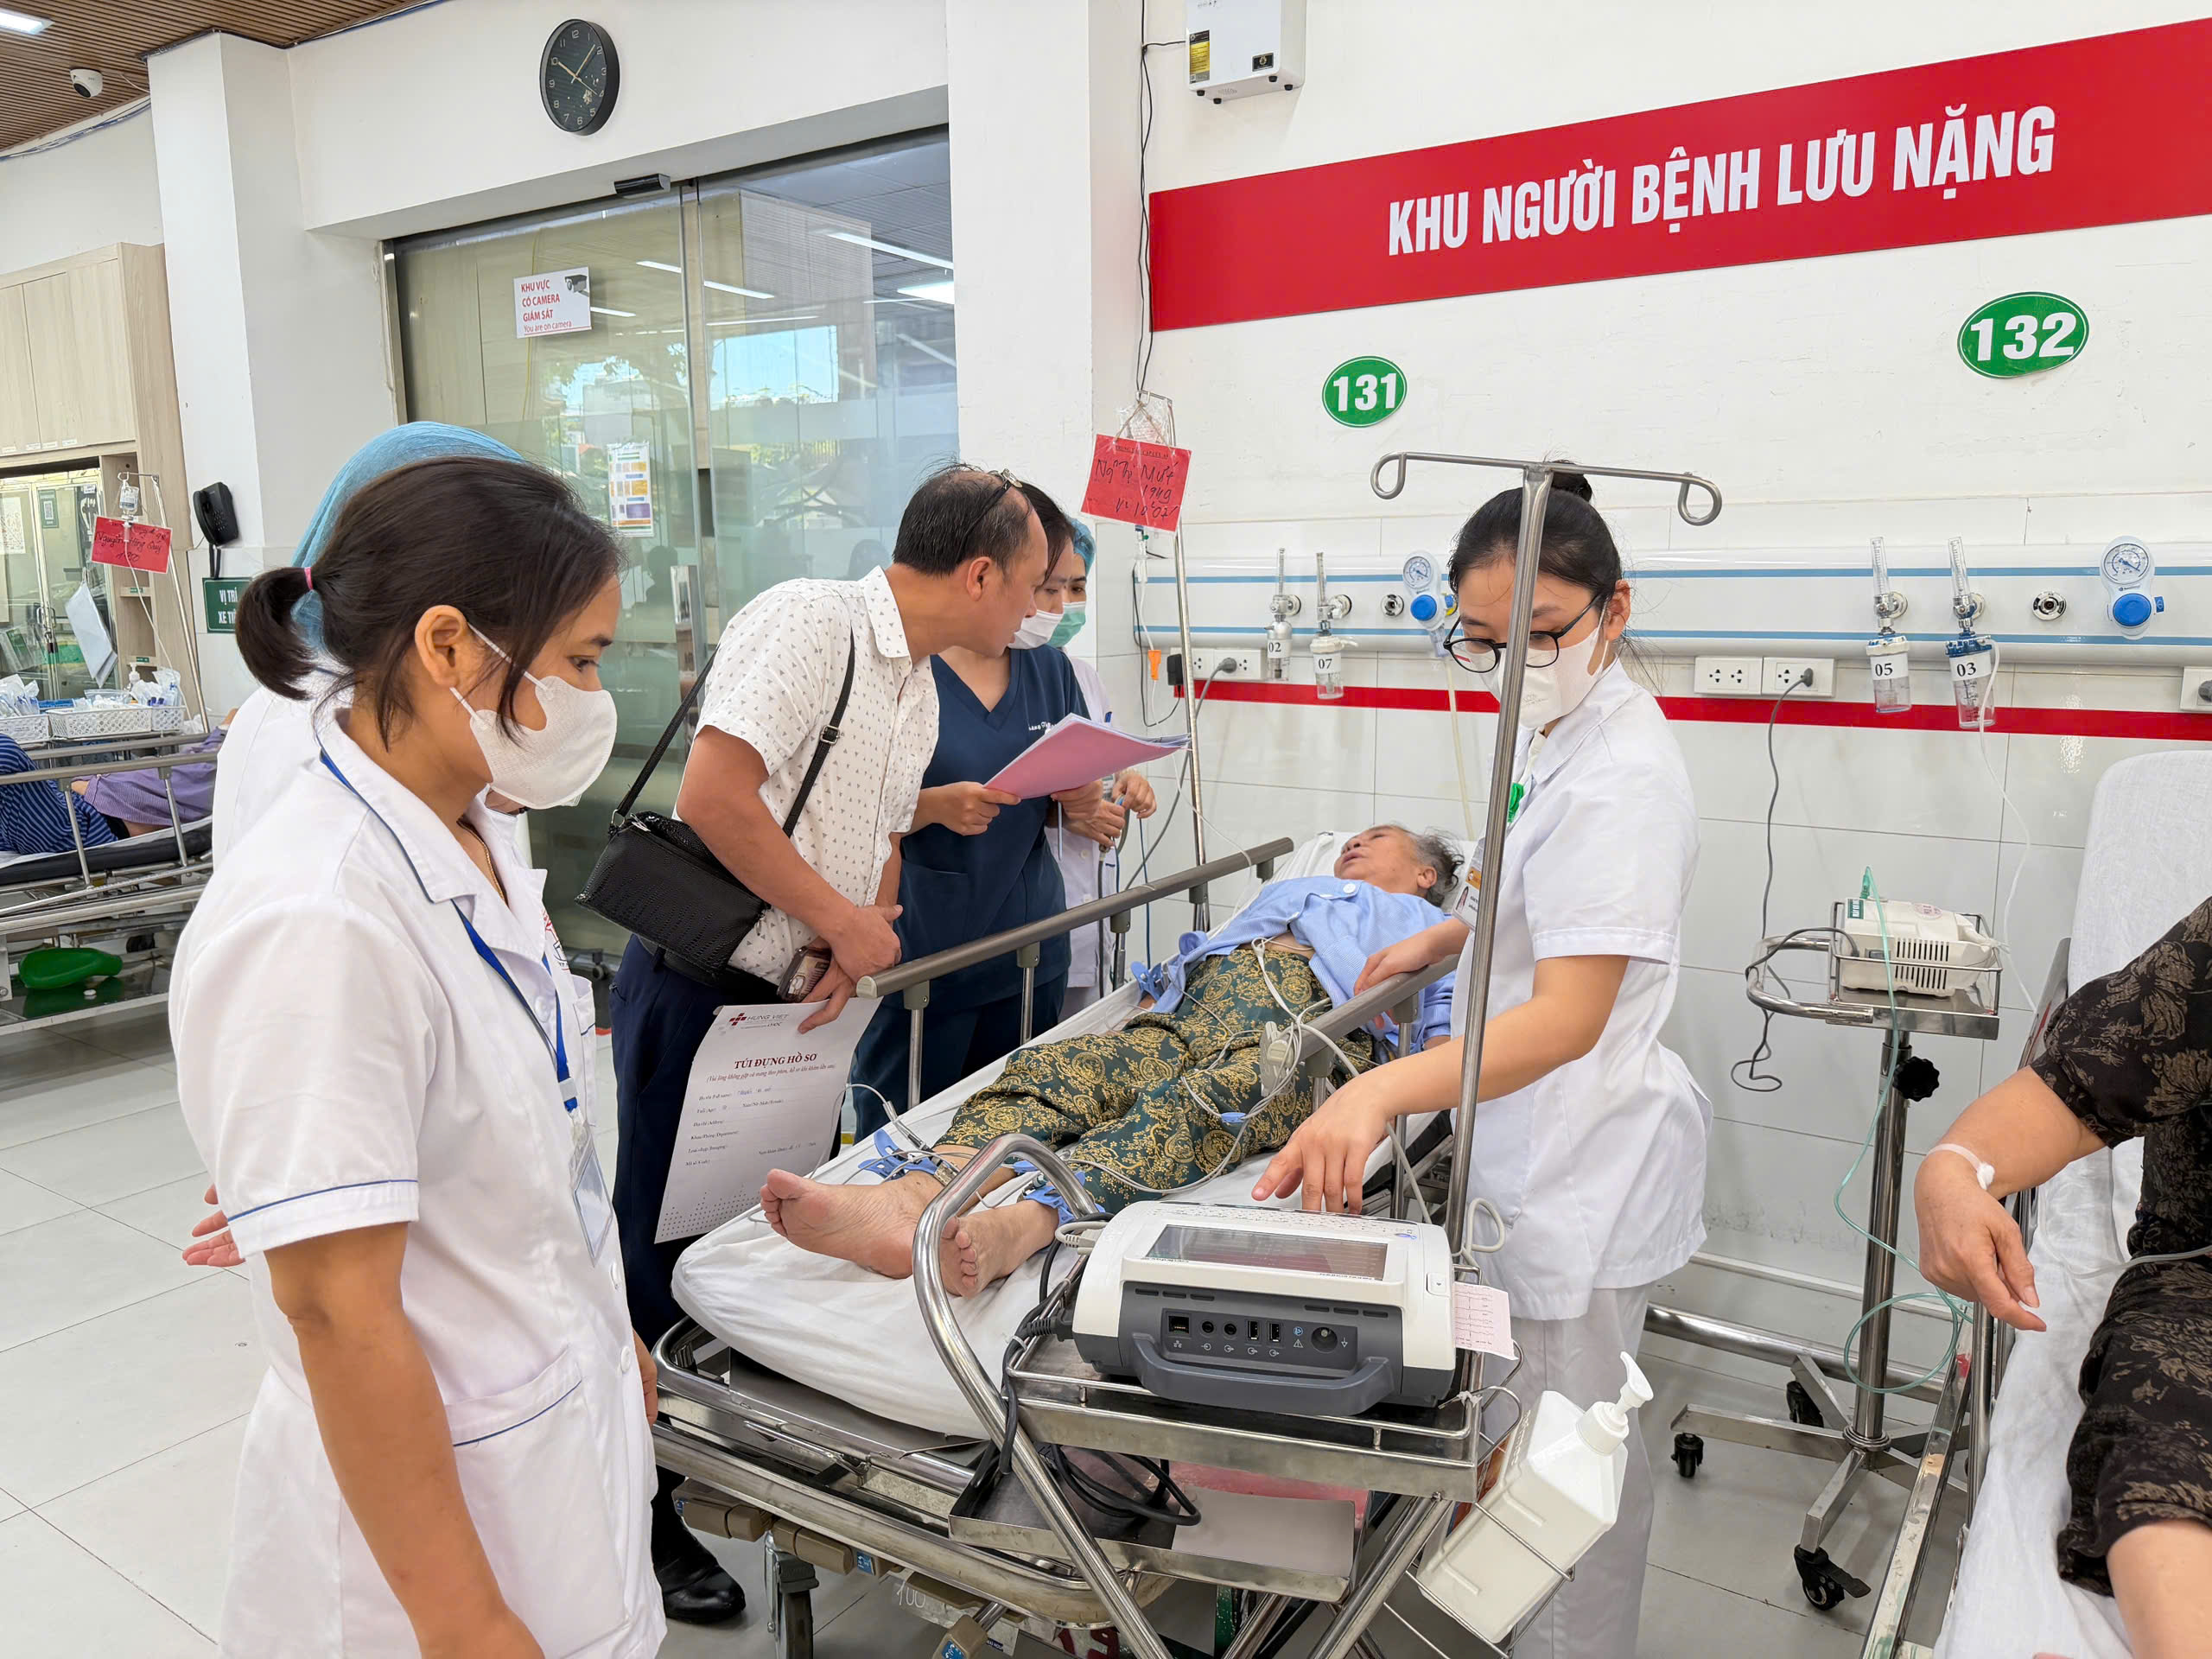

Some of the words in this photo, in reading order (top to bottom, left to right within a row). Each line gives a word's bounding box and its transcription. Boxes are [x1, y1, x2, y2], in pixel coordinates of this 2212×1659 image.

[571, 29, 580, 39] 12
[559, 39, 566, 48] 11
[596, 46, 603, 55] 2
[550, 56, 559, 66] 10
[601, 67, 607, 76] 3
[549, 79, 556, 88] 9
[599, 89, 605, 98] 4
[553, 99, 560, 109] 8
[563, 113, 569, 123] 7
[589, 108, 597, 117] 5
[577, 117, 583, 125] 6
[1389, 192, 1469, 256] KHU
[1483, 159, 1618, 244] NGƯỜI
[1631, 146, 1761, 234] BỆNH
[1777, 128, 1876, 206] LƯU
[1893, 103, 2056, 200] NẶNG
[521, 283, 535, 293] KHU
[536, 279, 550, 292] VỰC
[522, 296, 531, 308] CÓ
[532, 293, 561, 306] CAMERA
[523, 310, 541, 322] GIÁM
[542, 308, 554, 320] SÁT
[524, 324, 534, 333] You
[552, 320, 573, 329] camera
[1970, 311, 2077, 362] 132
[1333, 372, 1397, 412] 131
[219, 589, 227, 606] VỊ
[227, 587, 238, 603] TRÍ
[218, 611, 227, 624] XE
[1268, 642, 1281, 652] 02
[1318, 658, 1332, 670] 07
[1875, 662, 1893, 677] 05
[1956, 662, 1977, 677] 03
[734, 1056, 753, 1070] TÚI
[754, 1055, 785, 1069] ĐỰNG
[787, 1052, 803, 1064] HỒ
